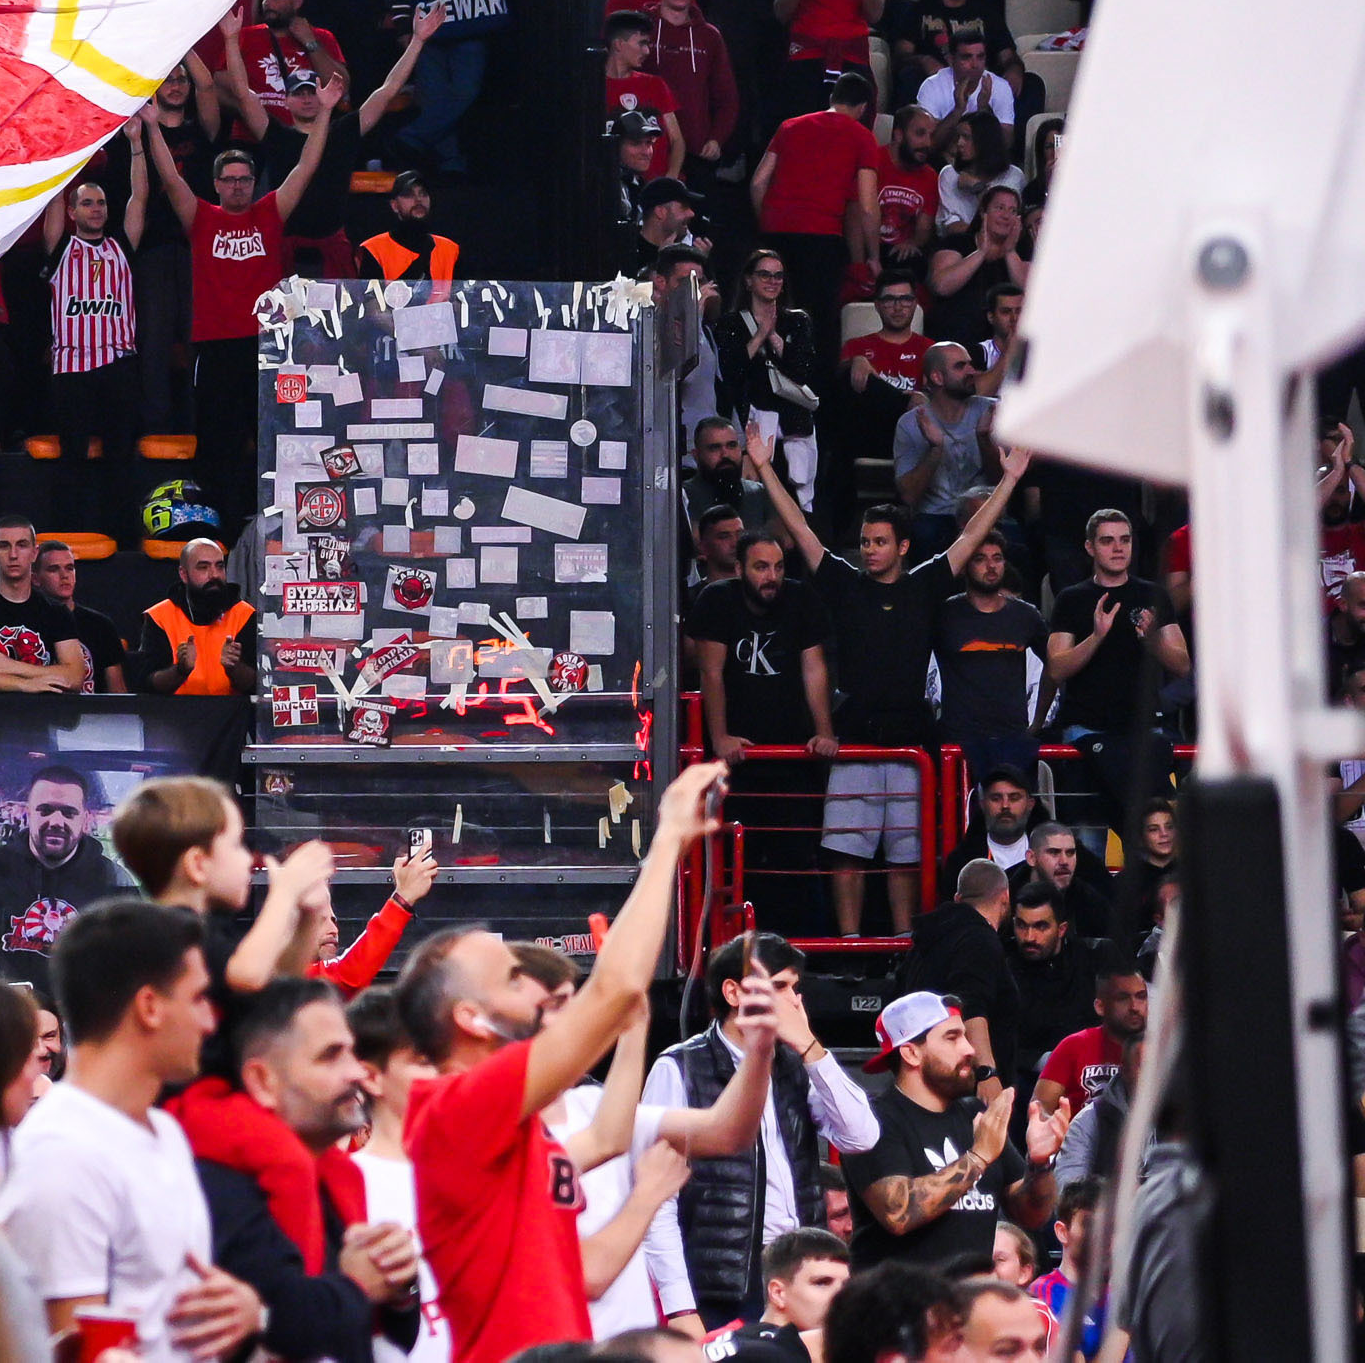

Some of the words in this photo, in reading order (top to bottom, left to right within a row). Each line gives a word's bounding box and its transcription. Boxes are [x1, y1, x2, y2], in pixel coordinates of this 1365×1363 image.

[90, 260, 103, 283] 7
[65, 293, 123, 319] bwin
[287, 586, 328, 599] ΘΥΡΑ
[736, 630, 781, 676] CK
[856, 996, 882, 1009] 122
